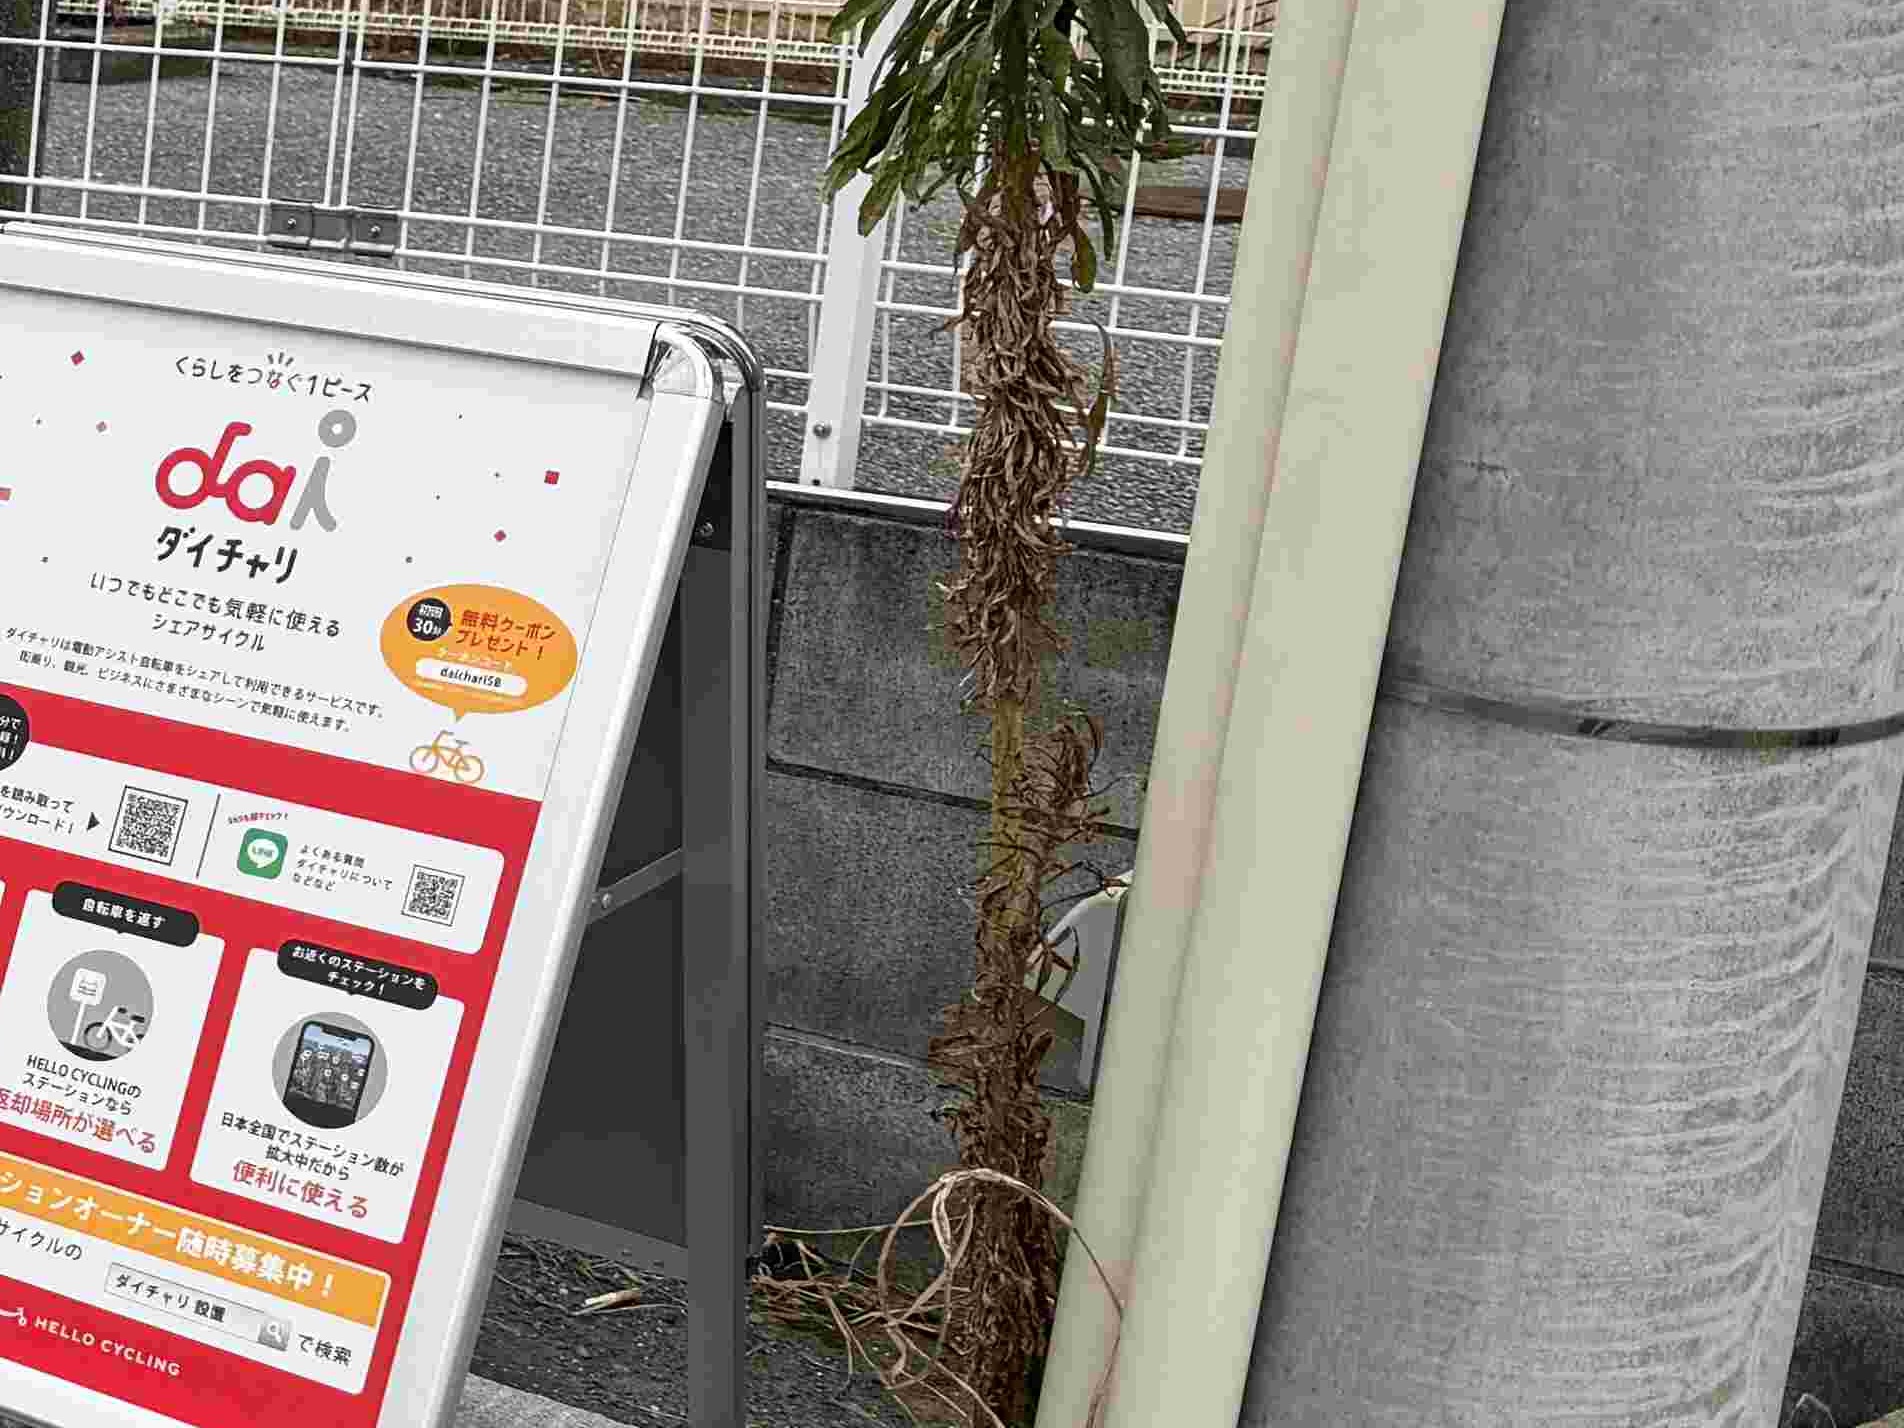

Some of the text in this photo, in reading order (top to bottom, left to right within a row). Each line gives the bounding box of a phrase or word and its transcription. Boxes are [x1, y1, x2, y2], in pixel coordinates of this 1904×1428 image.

[174, 355, 373, 403] くらしをつなぐ1ピース
[155, 409, 358, 532] dai
[155, 526, 299, 584] ダイチャリ
[90, 573, 341, 638] いつでもどこでも気軽に使える
[461, 609, 556, 641] 無料クーポン
[152, 613, 266, 653] シェアサイクル
[296, 858, 393, 891] ダイチャリについて
[299, 845, 365, 868] よくある質問
[293, 873, 337, 892] などなど
[82, 898, 166, 930] 自転車を返す
[292, 945, 426, 991] お近くのステーションを
[23, 1072, 132, 1116] ステーションなら
[27, 1055, 142, 1099] HELLO CYCLINGの
[220, 1111, 405, 1177] 日本全国でステーション数が
[265, 1144, 350, 1182] 拡大中だから
[233, 1159, 369, 1218] 便利に使える
[115, 1273, 191, 1311] ダイチャリ
[194, 1299, 227, 1324] 設置
[33, 1316, 182, 1377] HELLO CYCLING
